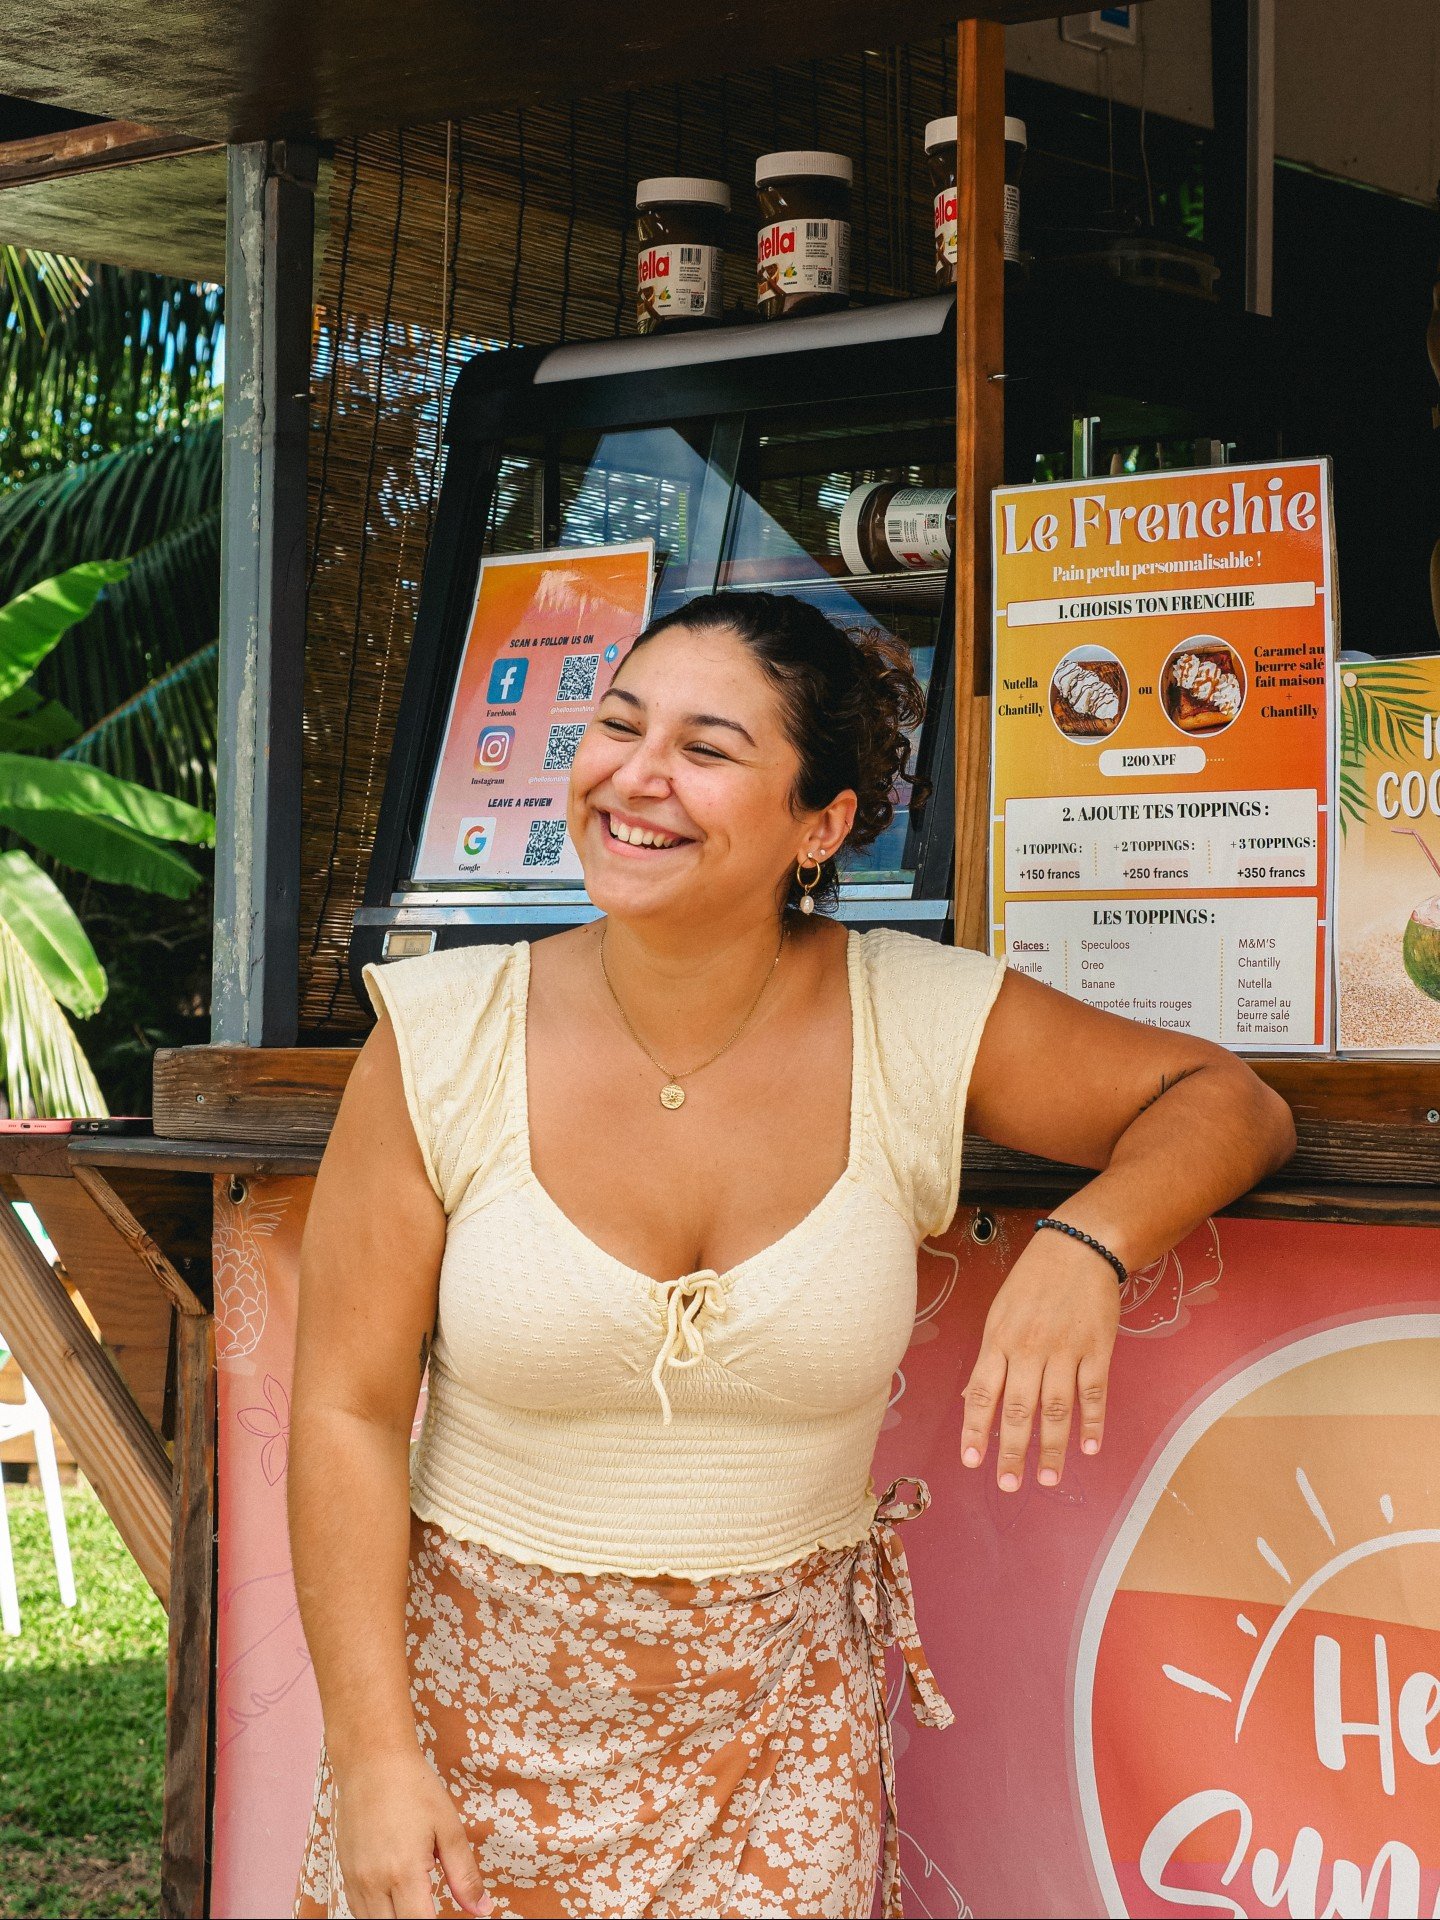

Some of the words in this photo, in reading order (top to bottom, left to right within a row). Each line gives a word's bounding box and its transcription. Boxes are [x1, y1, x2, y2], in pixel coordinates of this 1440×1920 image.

[757, 226, 795, 263] tella
[1003, 504, 1059, 555] Le
[1071, 477, 1316, 548] Frenchie
[1053, 564, 1084, 582] Pain
[1086, 560, 1130, 584] perdu
[1132, 550, 1254, 580] personnalisable
[1070, 599, 1132, 618] CHOISIS
[1135, 597, 1169, 614] TON
[1171, 591, 1255, 611] FRENCHIE
[510, 639, 530, 648] SCAN
[532, 639, 538, 647] &
[540, 637, 569, 646] FOLLOW
[572, 636, 581, 644] US
[583, 635, 594, 644] ON
[1254, 643, 1306, 657] Caramel
[1309, 646, 1325, 655] au
[1255, 661, 1297, 673] beurre
[1299, 658, 1325, 671] salé
[1002, 677, 1039, 690] Nutella
[1255, 676, 1276, 688] fait
[1279, 674, 1324, 687] maison
[1138, 686, 1153, 695] ou
[486, 708, 517, 717] Facebook
[998, 703, 1045, 717] Chantilly
[1261, 704, 1319, 719] Chantilly
[1121, 754, 1150, 768] 1200
[1152, 753, 1177, 767] XPF
[471, 777, 505, 787] Instagram
[487, 798, 514, 808] LEAVE
[515, 798, 521, 807] A
[523, 797, 553, 807] REVIEW
[1062, 807, 1075, 822] 2.
[1077, 804, 1139, 821] AJOUTE
[1143, 803, 1174, 819] TES
[1176, 801, 1262, 818] TOPPINGS
[1029, 843, 1077, 855] TOPPING
[1121, 841, 1128, 852] 2
[1129, 840, 1190, 852] TOPPINGS
[1239, 838, 1246, 849] 3
[1249, 837, 1310, 849] TOPPINGS
[458, 863, 481, 873] Google
[1019, 868, 1044, 880] +150
[1047, 867, 1080, 880] francs
[1122, 868, 1151, 879] +250
[1152, 867, 1189, 879] francs
[1237, 867, 1267, 878] +350
[1269, 866, 1306, 878] francs
[1092, 910, 1122, 925] LES
[1125, 909, 1208, 925] TOPPINGS
[1012, 940, 1044, 951] Glaces
[1081, 940, 1130, 951] Speculoos
[1238, 938, 1276, 949] M&M'S
[1013, 962, 1042, 973] Vanille
[1081, 960, 1104, 971] Oreo
[1238, 957, 1281, 969] Chantilly
[1081, 979, 1115, 989] Banane
[1237, 979, 1272, 989] Nutella
[1081, 998, 1130, 1010] Compotée
[1133, 998, 1156, 1008] fruits
[1159, 1001, 1192, 1011] rouges
[1237, 997, 1276, 1008] Caramel
[1279, 1000, 1291, 1008] au
[1237, 1010, 1269, 1020] beurre
[1271, 1009, 1290, 1020] salé
[1160, 1016, 1191, 1027] locaux
[1236, 1022, 1251, 1033] fait
[1254, 1023, 1288, 1033] maison
[1139, 1788, 1440, 1919] Sun
